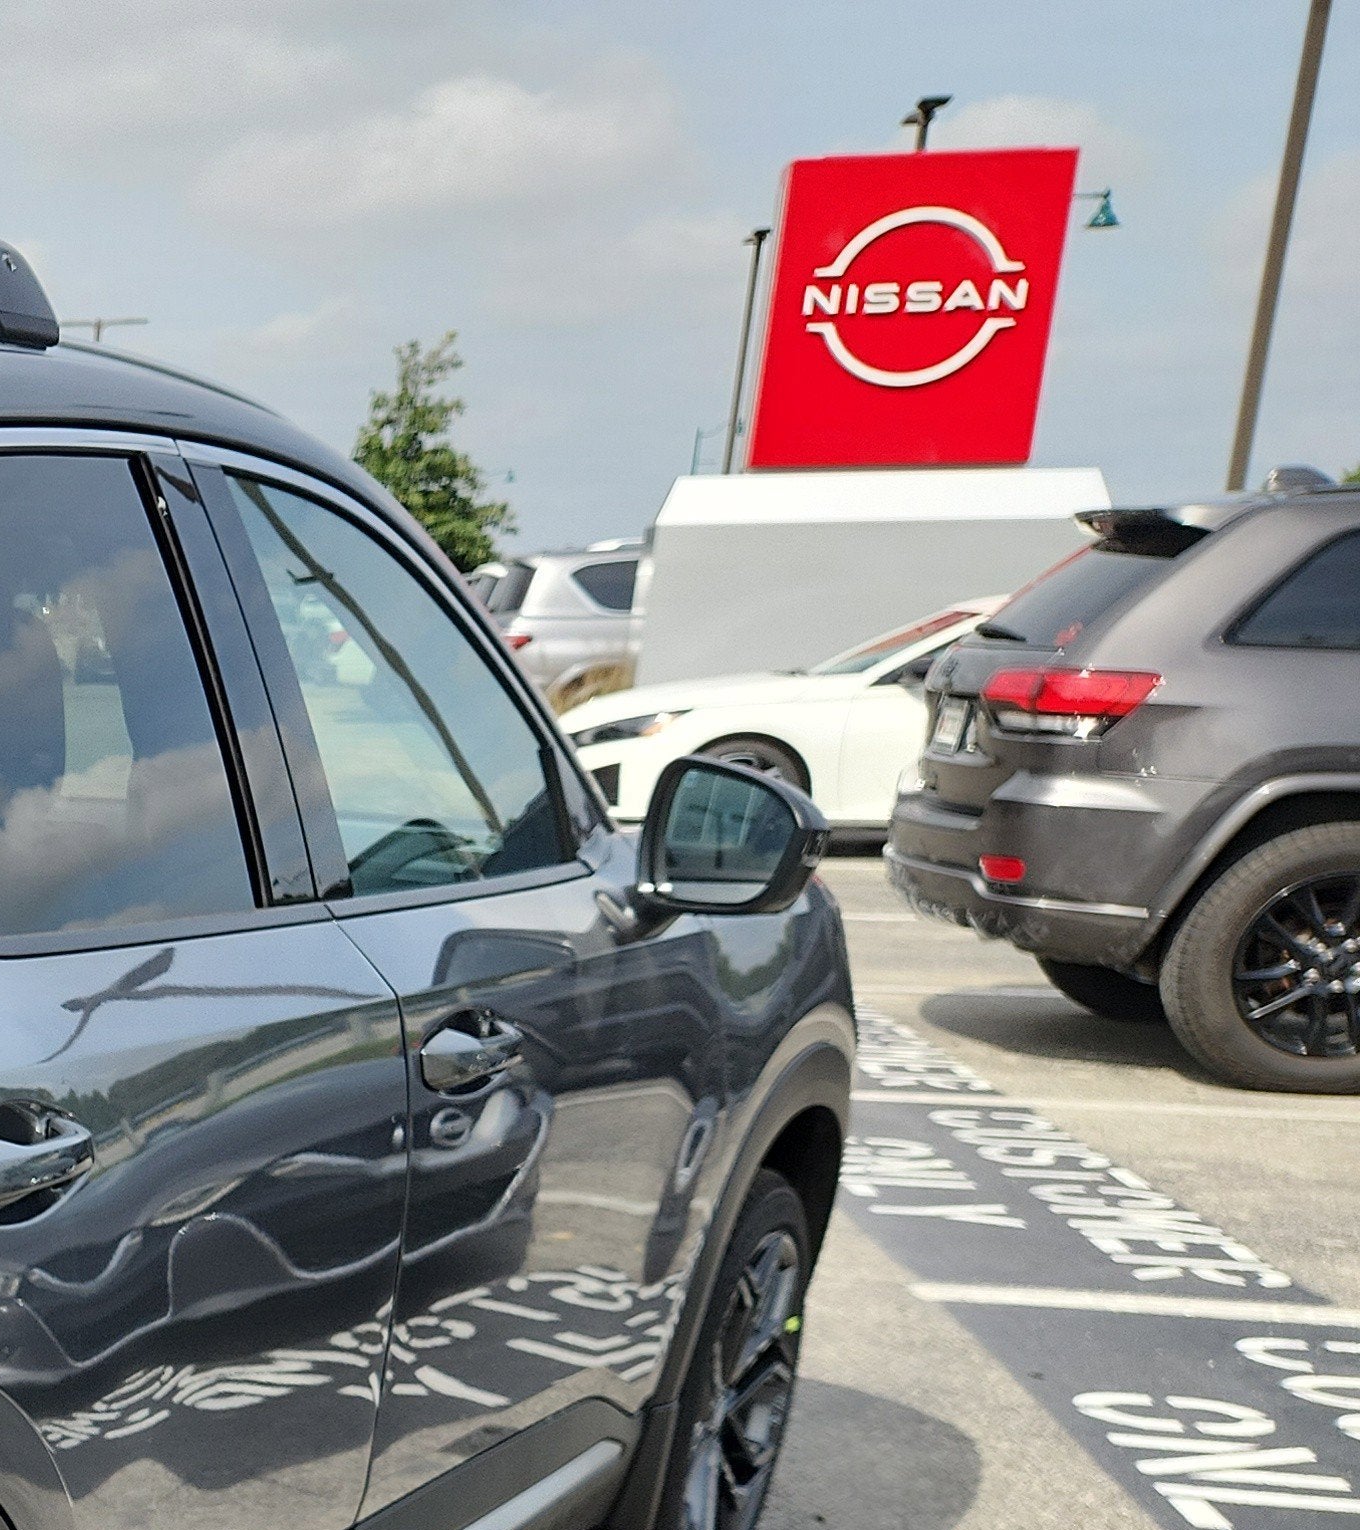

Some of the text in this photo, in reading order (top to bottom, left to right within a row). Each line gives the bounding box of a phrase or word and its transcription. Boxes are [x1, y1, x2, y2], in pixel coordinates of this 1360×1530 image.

[802, 278, 1029, 316] NISSAN
[838, 1135, 1028, 1231] ONLY
[928, 1108, 1292, 1289] CUSTOMER
